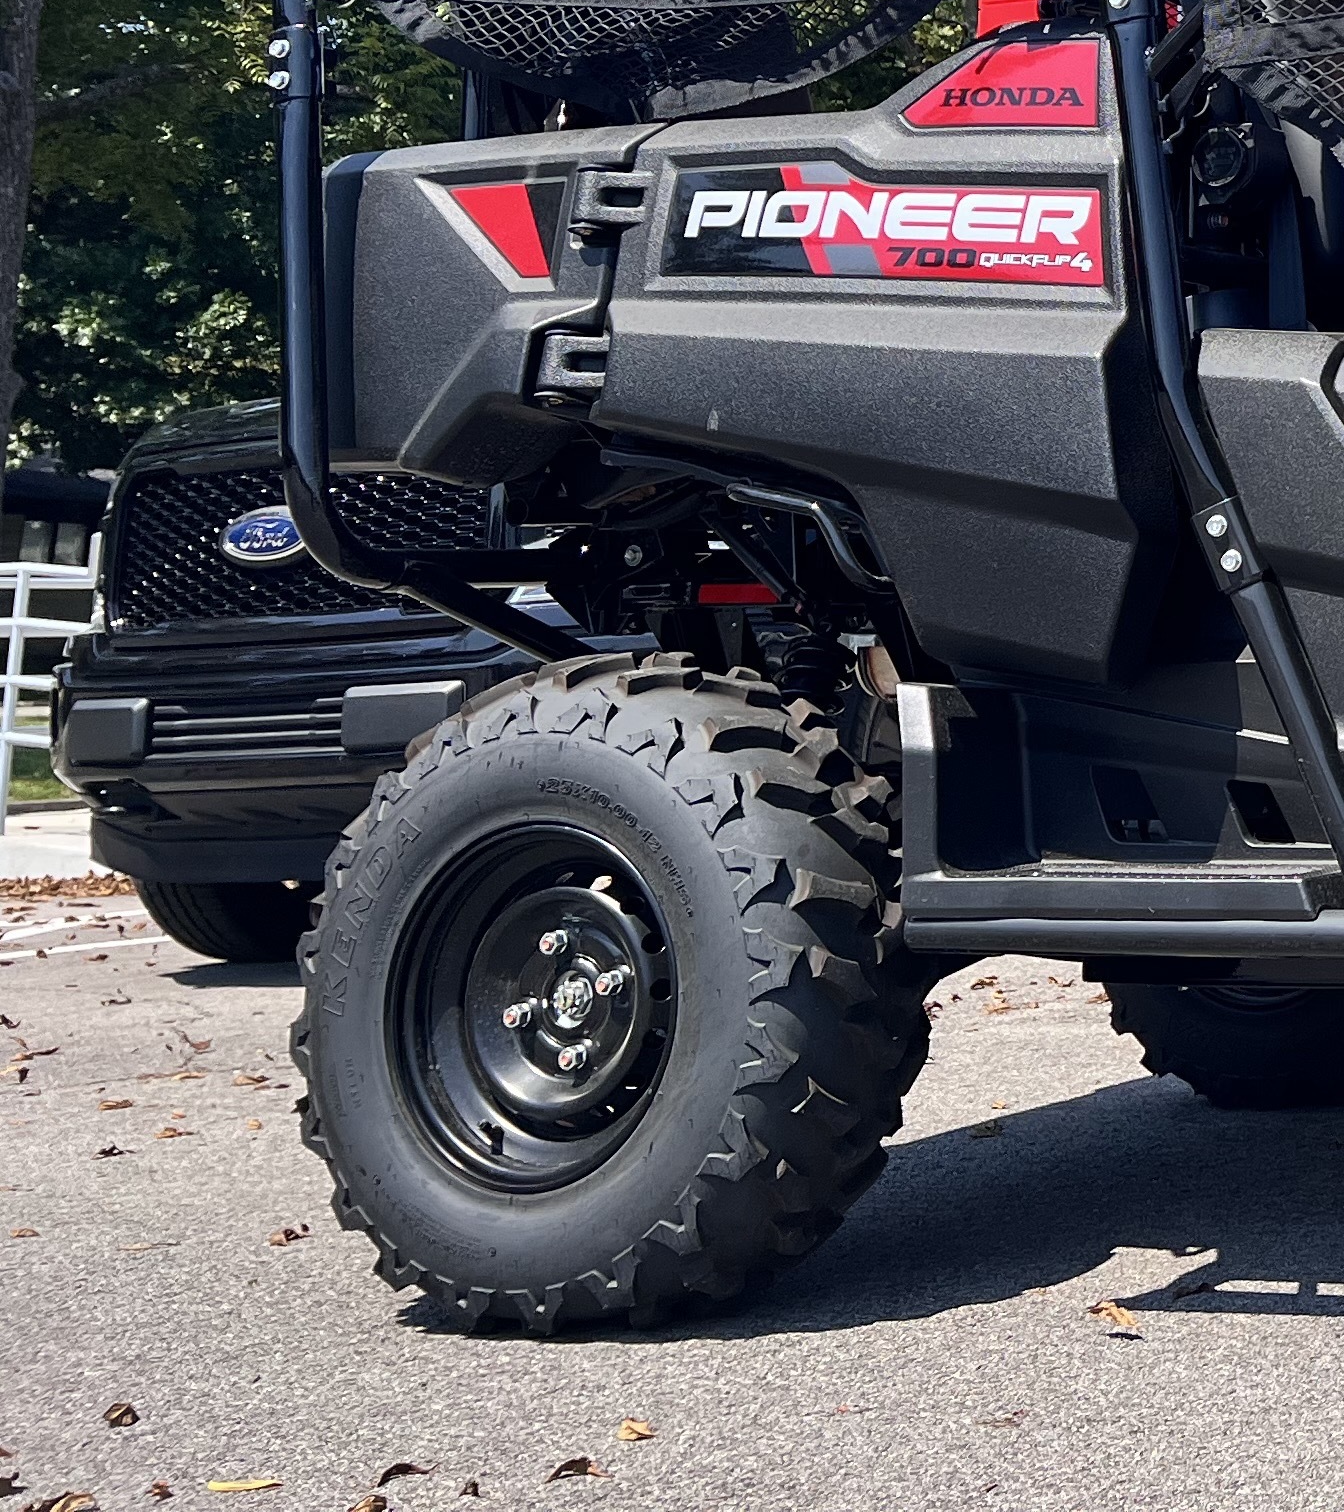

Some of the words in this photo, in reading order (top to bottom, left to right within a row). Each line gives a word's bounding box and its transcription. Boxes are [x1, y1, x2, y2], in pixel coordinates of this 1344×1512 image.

[941, 87, 1084, 107] HONDA
[684, 190, 1092, 245] PIONEER
[887, 246, 977, 268] 700
[239, 522, 290, 549] Ford
[322, 817, 422, 1017] KENDA
